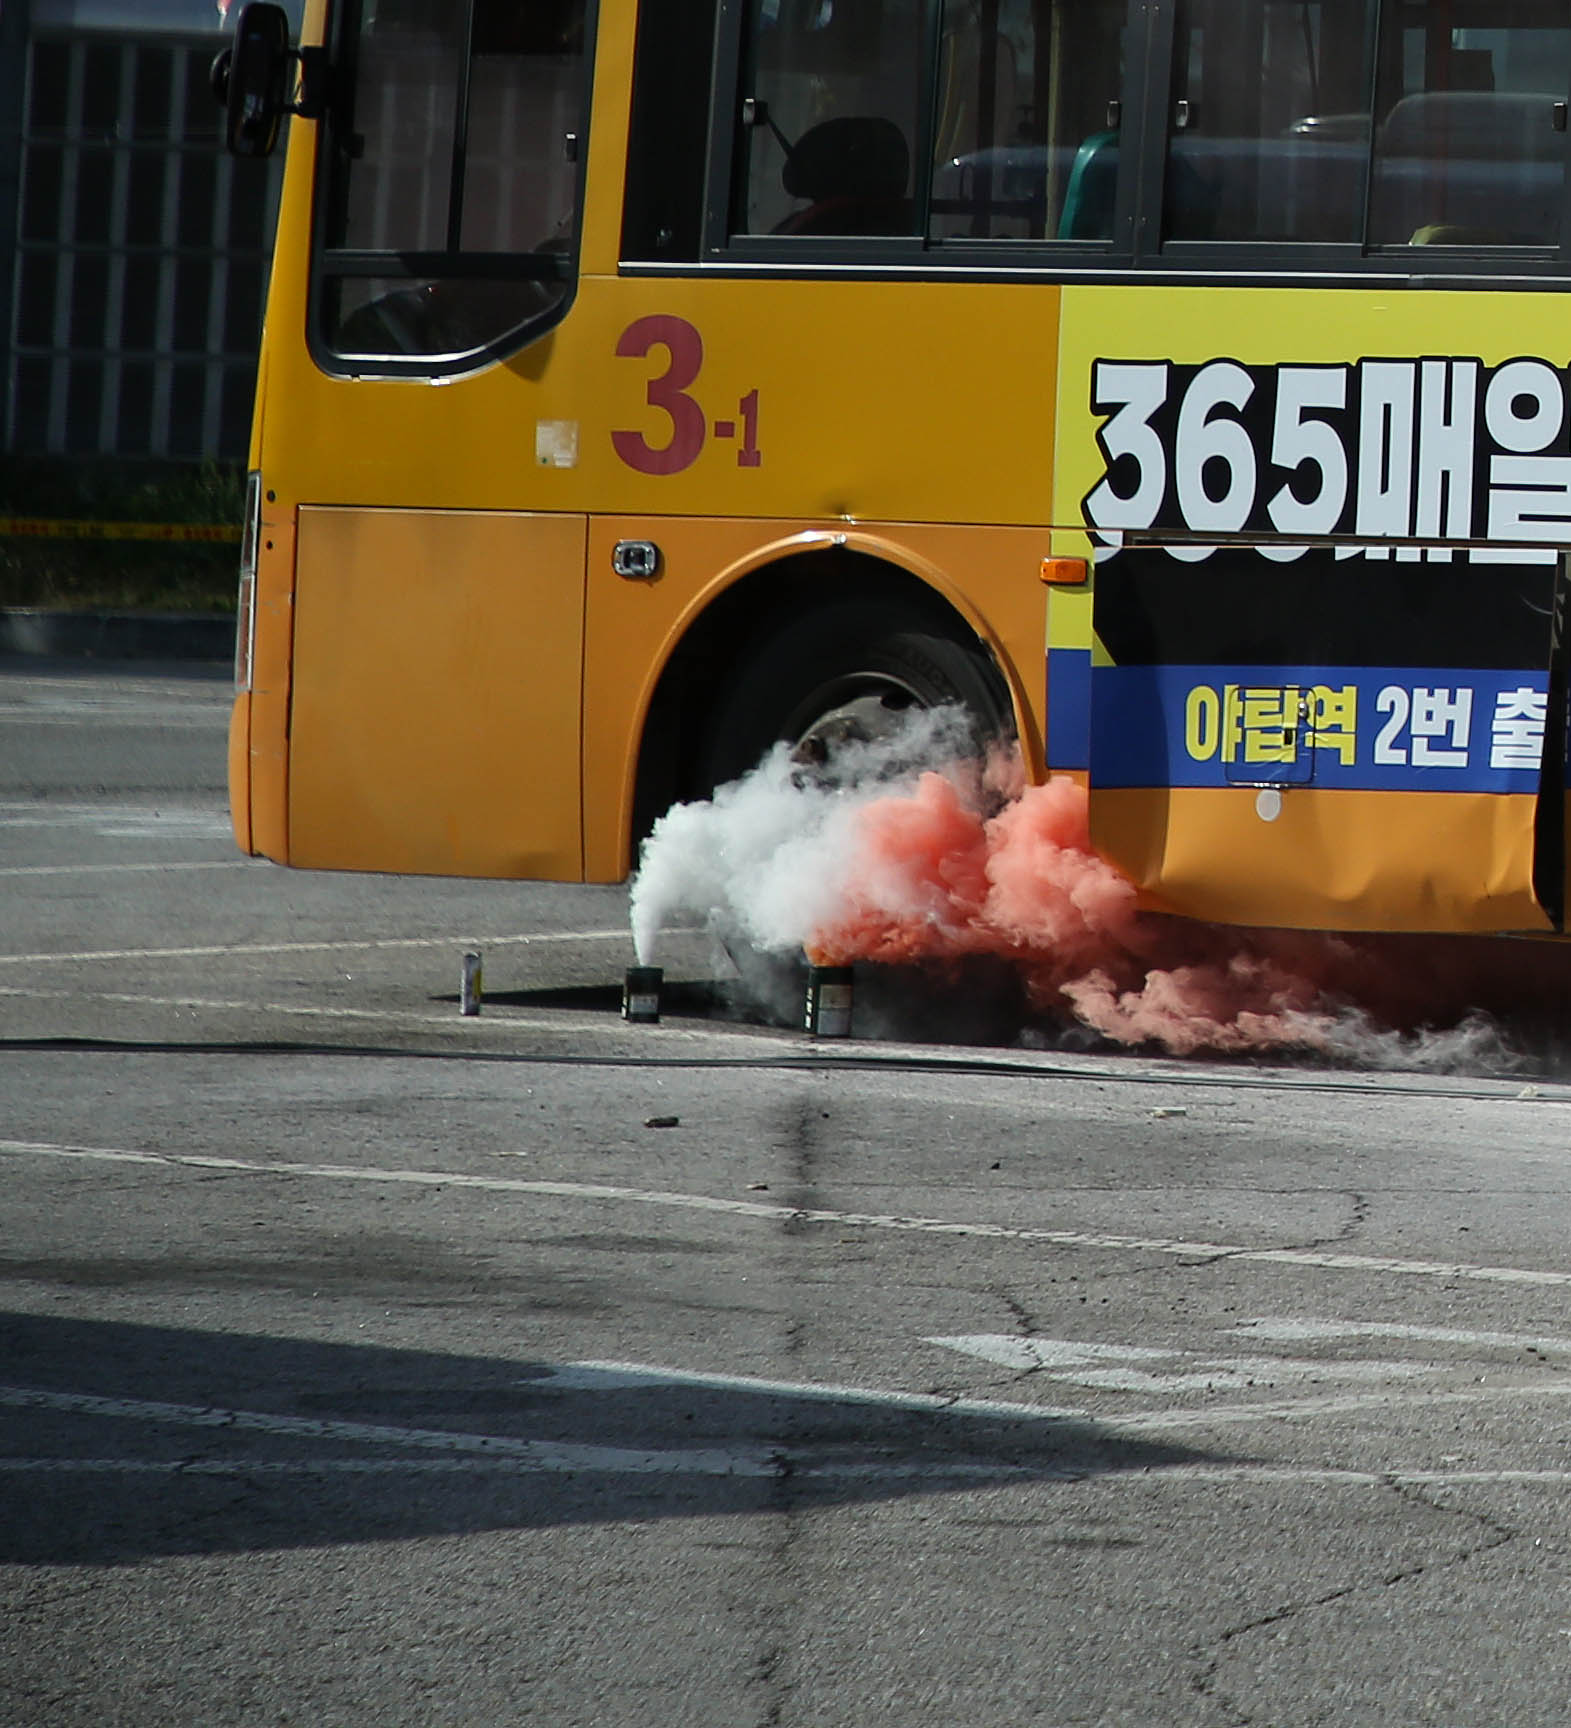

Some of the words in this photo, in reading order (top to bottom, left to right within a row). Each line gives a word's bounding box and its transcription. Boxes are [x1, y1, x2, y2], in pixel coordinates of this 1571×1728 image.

[610, 314, 761, 476] 3-1
[1184, 684, 1357, 766] 야탑역
[1373, 685, 1473, 768] 2번
